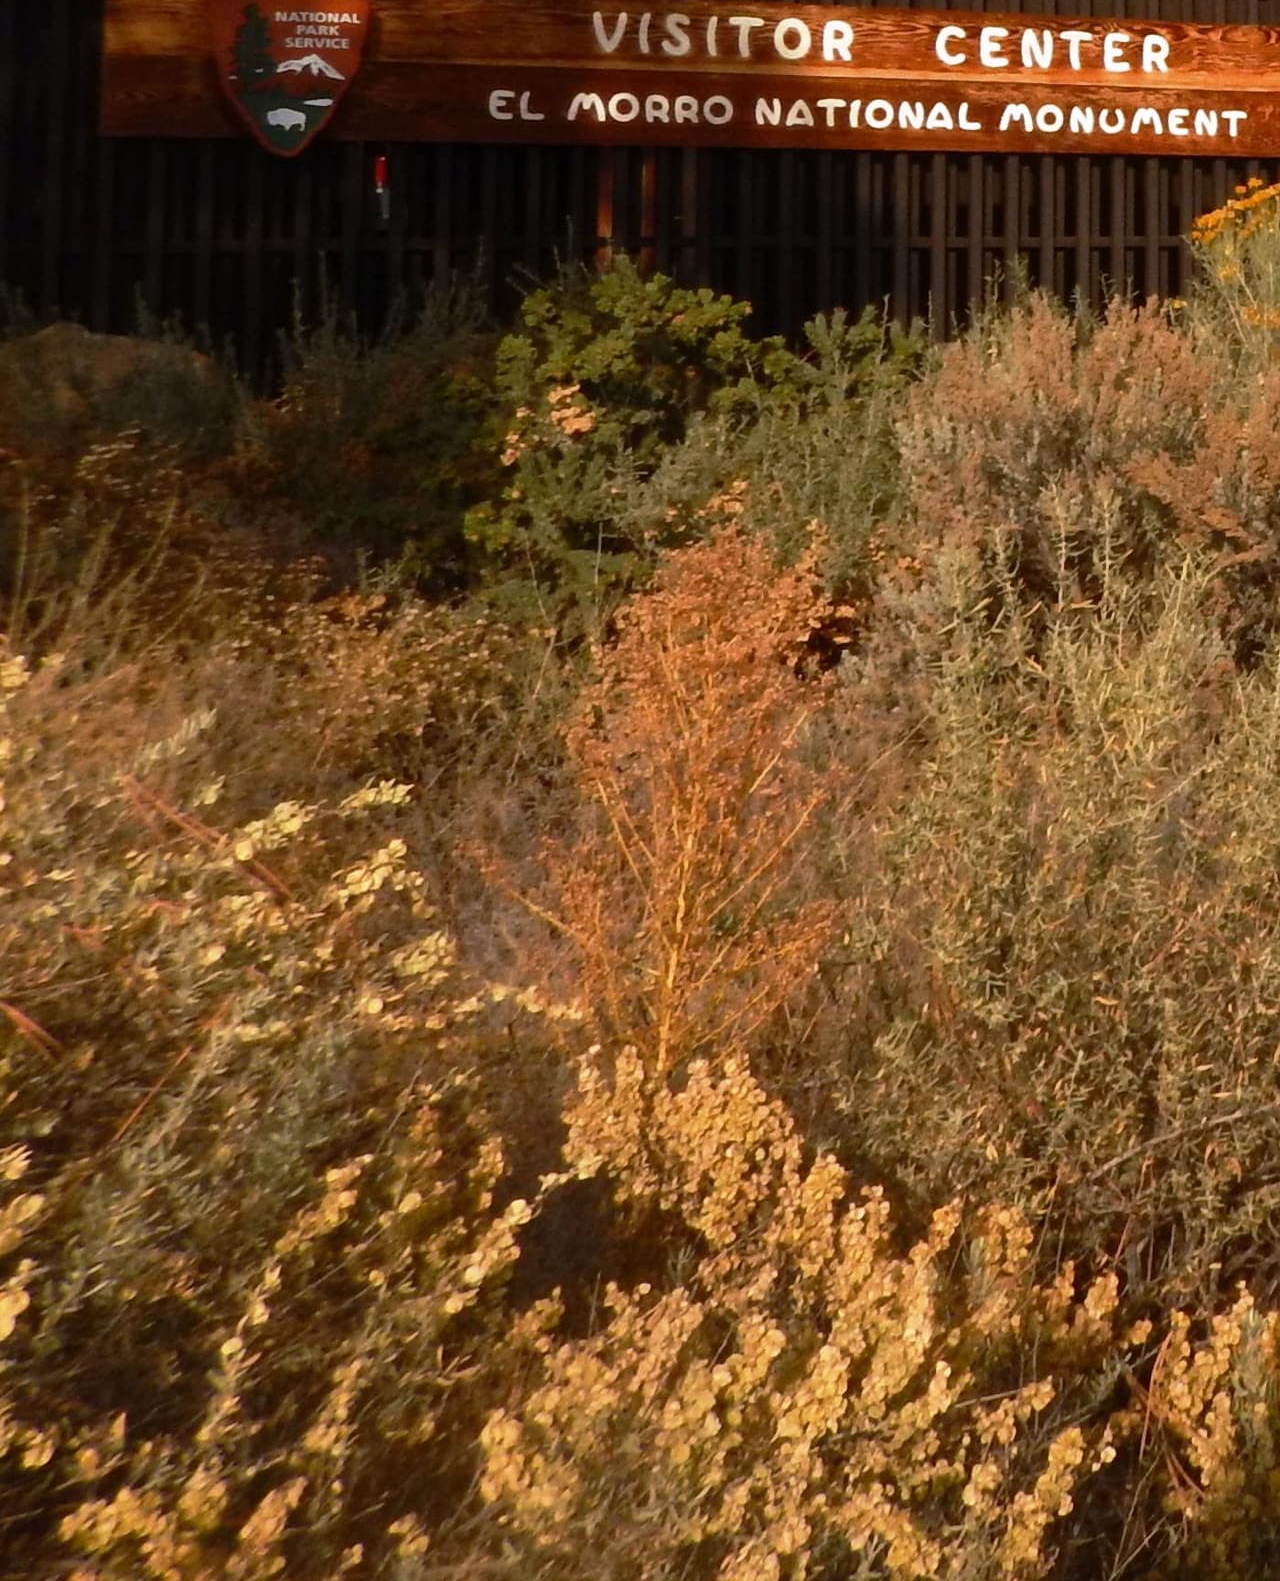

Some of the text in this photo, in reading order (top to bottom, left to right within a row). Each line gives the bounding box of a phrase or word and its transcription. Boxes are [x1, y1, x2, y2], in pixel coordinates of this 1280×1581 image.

[275, 11, 361, 24] NATIONAL
[296, 25, 340, 36] PARK
[285, 38, 350, 49] SERVICE
[593, 11, 1170, 75] VISITOR CENTER
[489, 90, 1248, 138] EL MORRO NATIONAL MONUMENT
